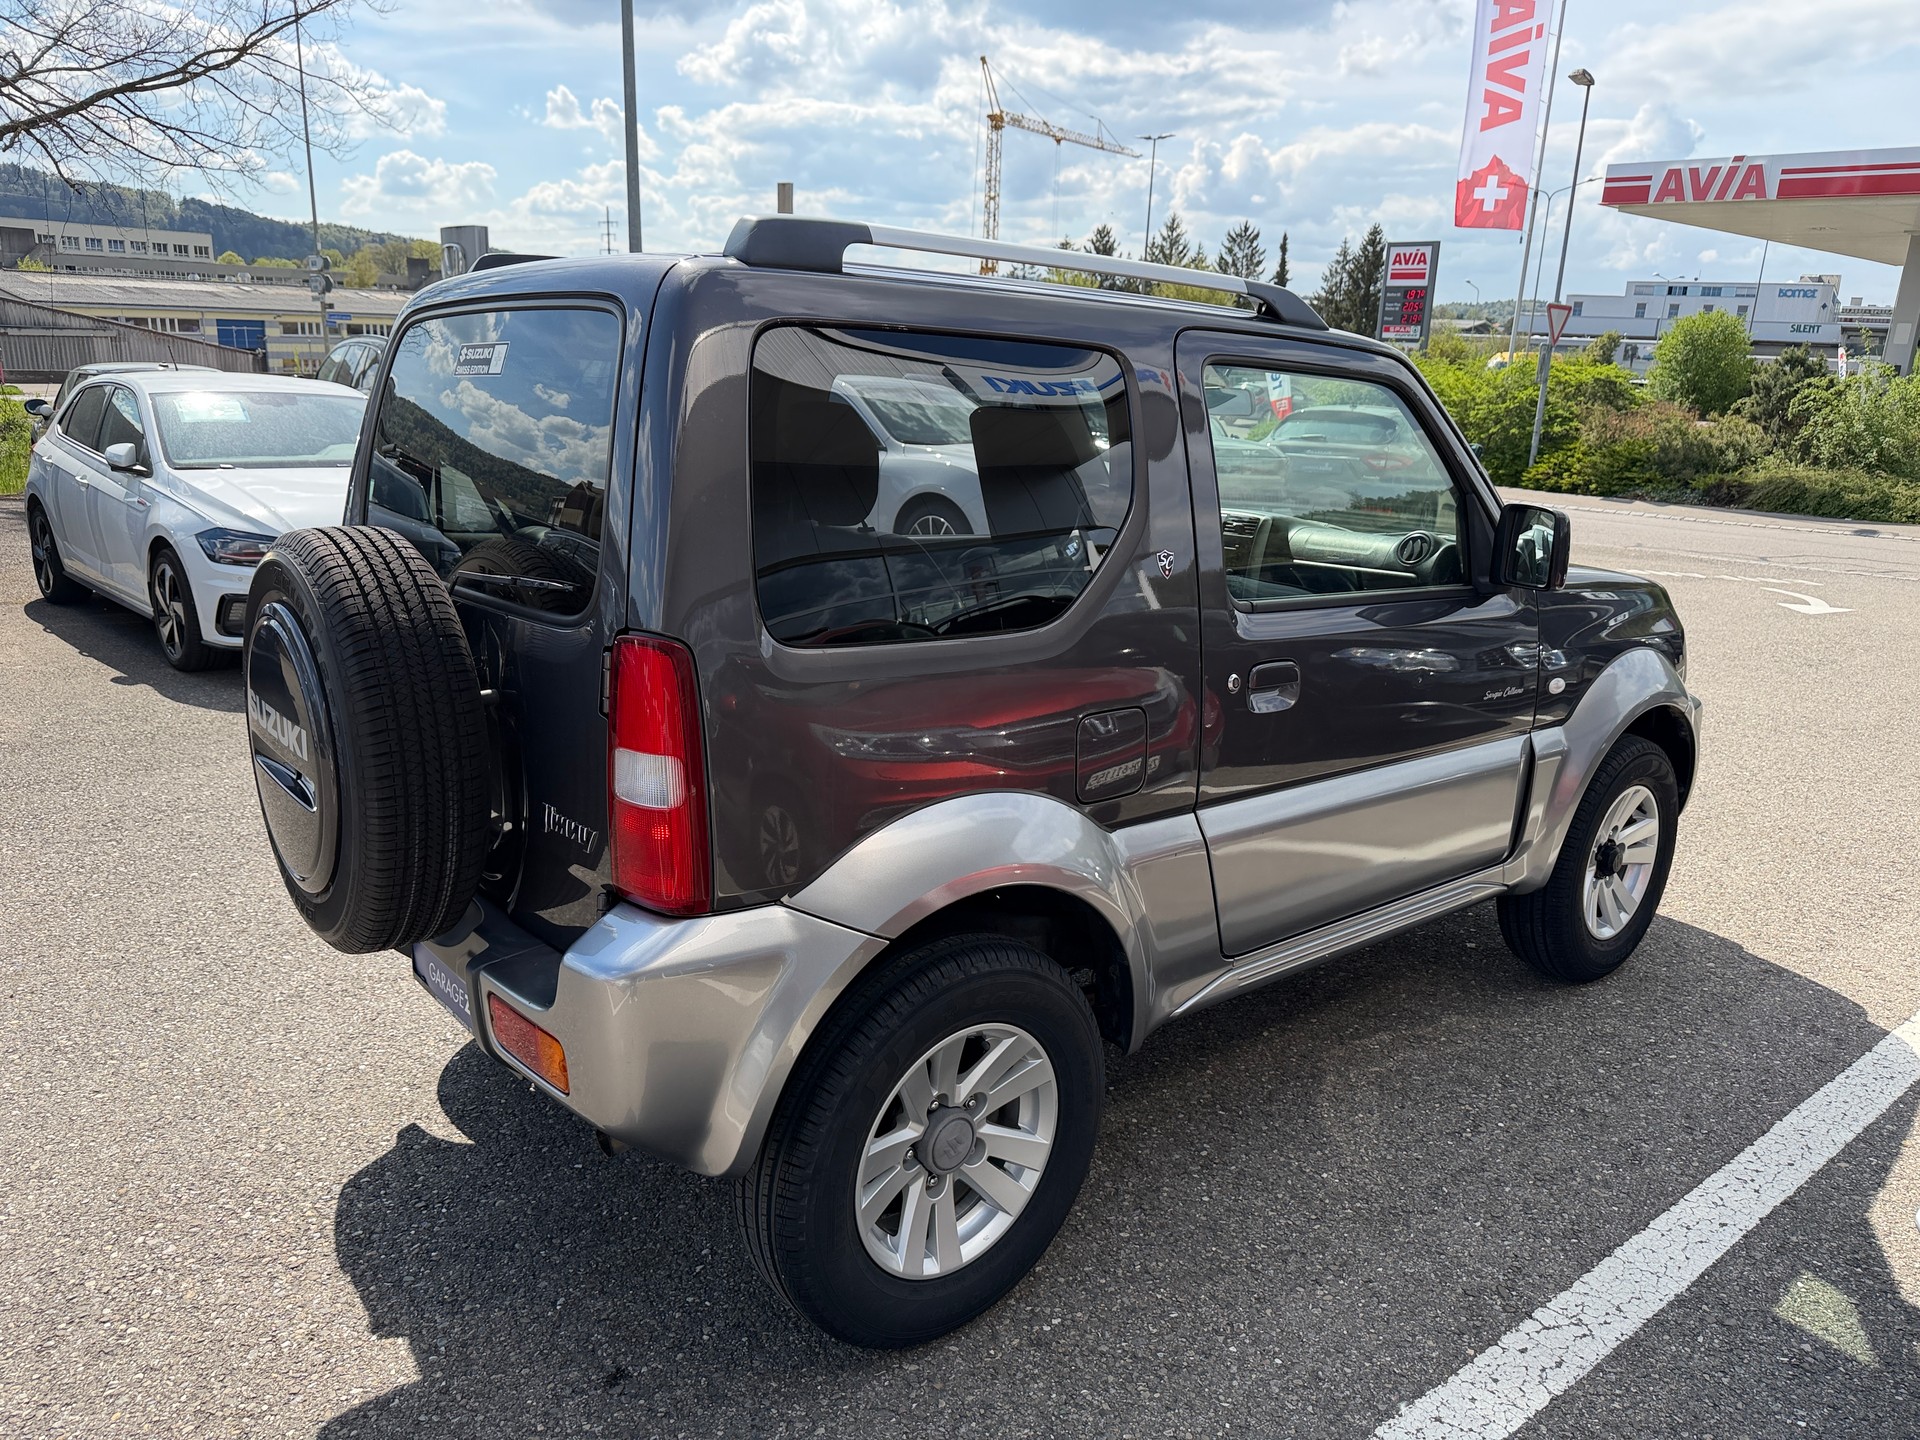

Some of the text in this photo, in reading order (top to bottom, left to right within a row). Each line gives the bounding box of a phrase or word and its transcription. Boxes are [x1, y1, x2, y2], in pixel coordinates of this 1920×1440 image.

[1790, 324, 1821, 334] SILENT
[466, 348, 493, 359] SUZUKI
[456, 365, 489, 374] SWISS EDITION
[250, 688, 308, 762] SUZUKI
[428, 962, 466, 1009] GARAGE
